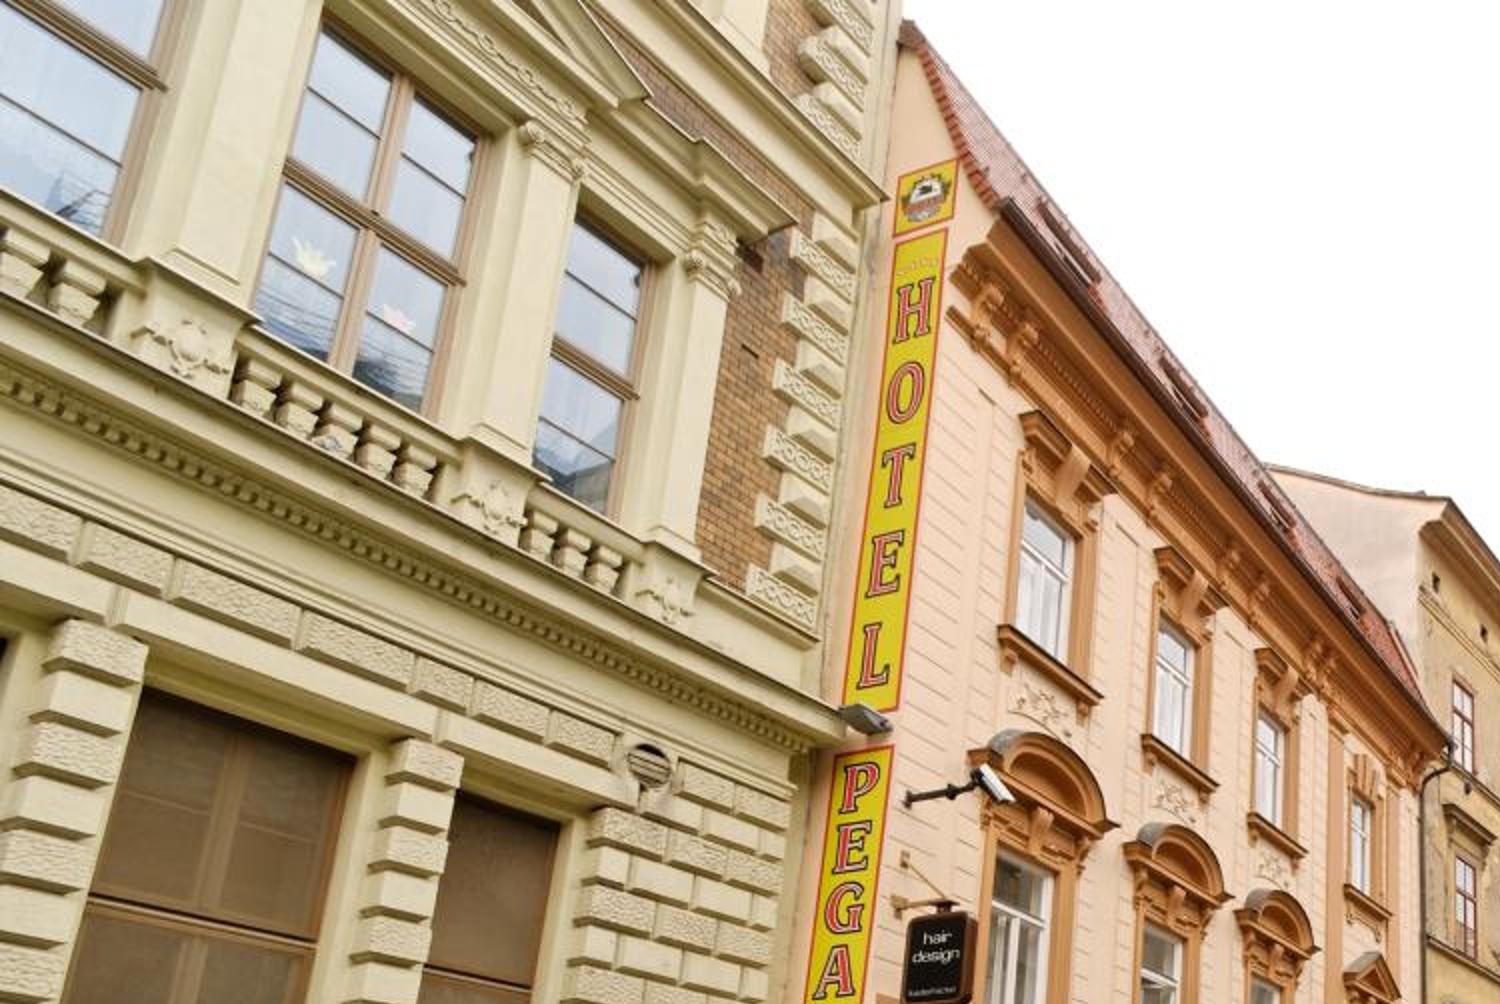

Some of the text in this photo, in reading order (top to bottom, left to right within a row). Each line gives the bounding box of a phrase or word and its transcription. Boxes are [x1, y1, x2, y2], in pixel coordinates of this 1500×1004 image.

[856, 276, 937, 690] HOTEL
[923, 930, 952, 945] hair
[911, 948, 960, 965] design
